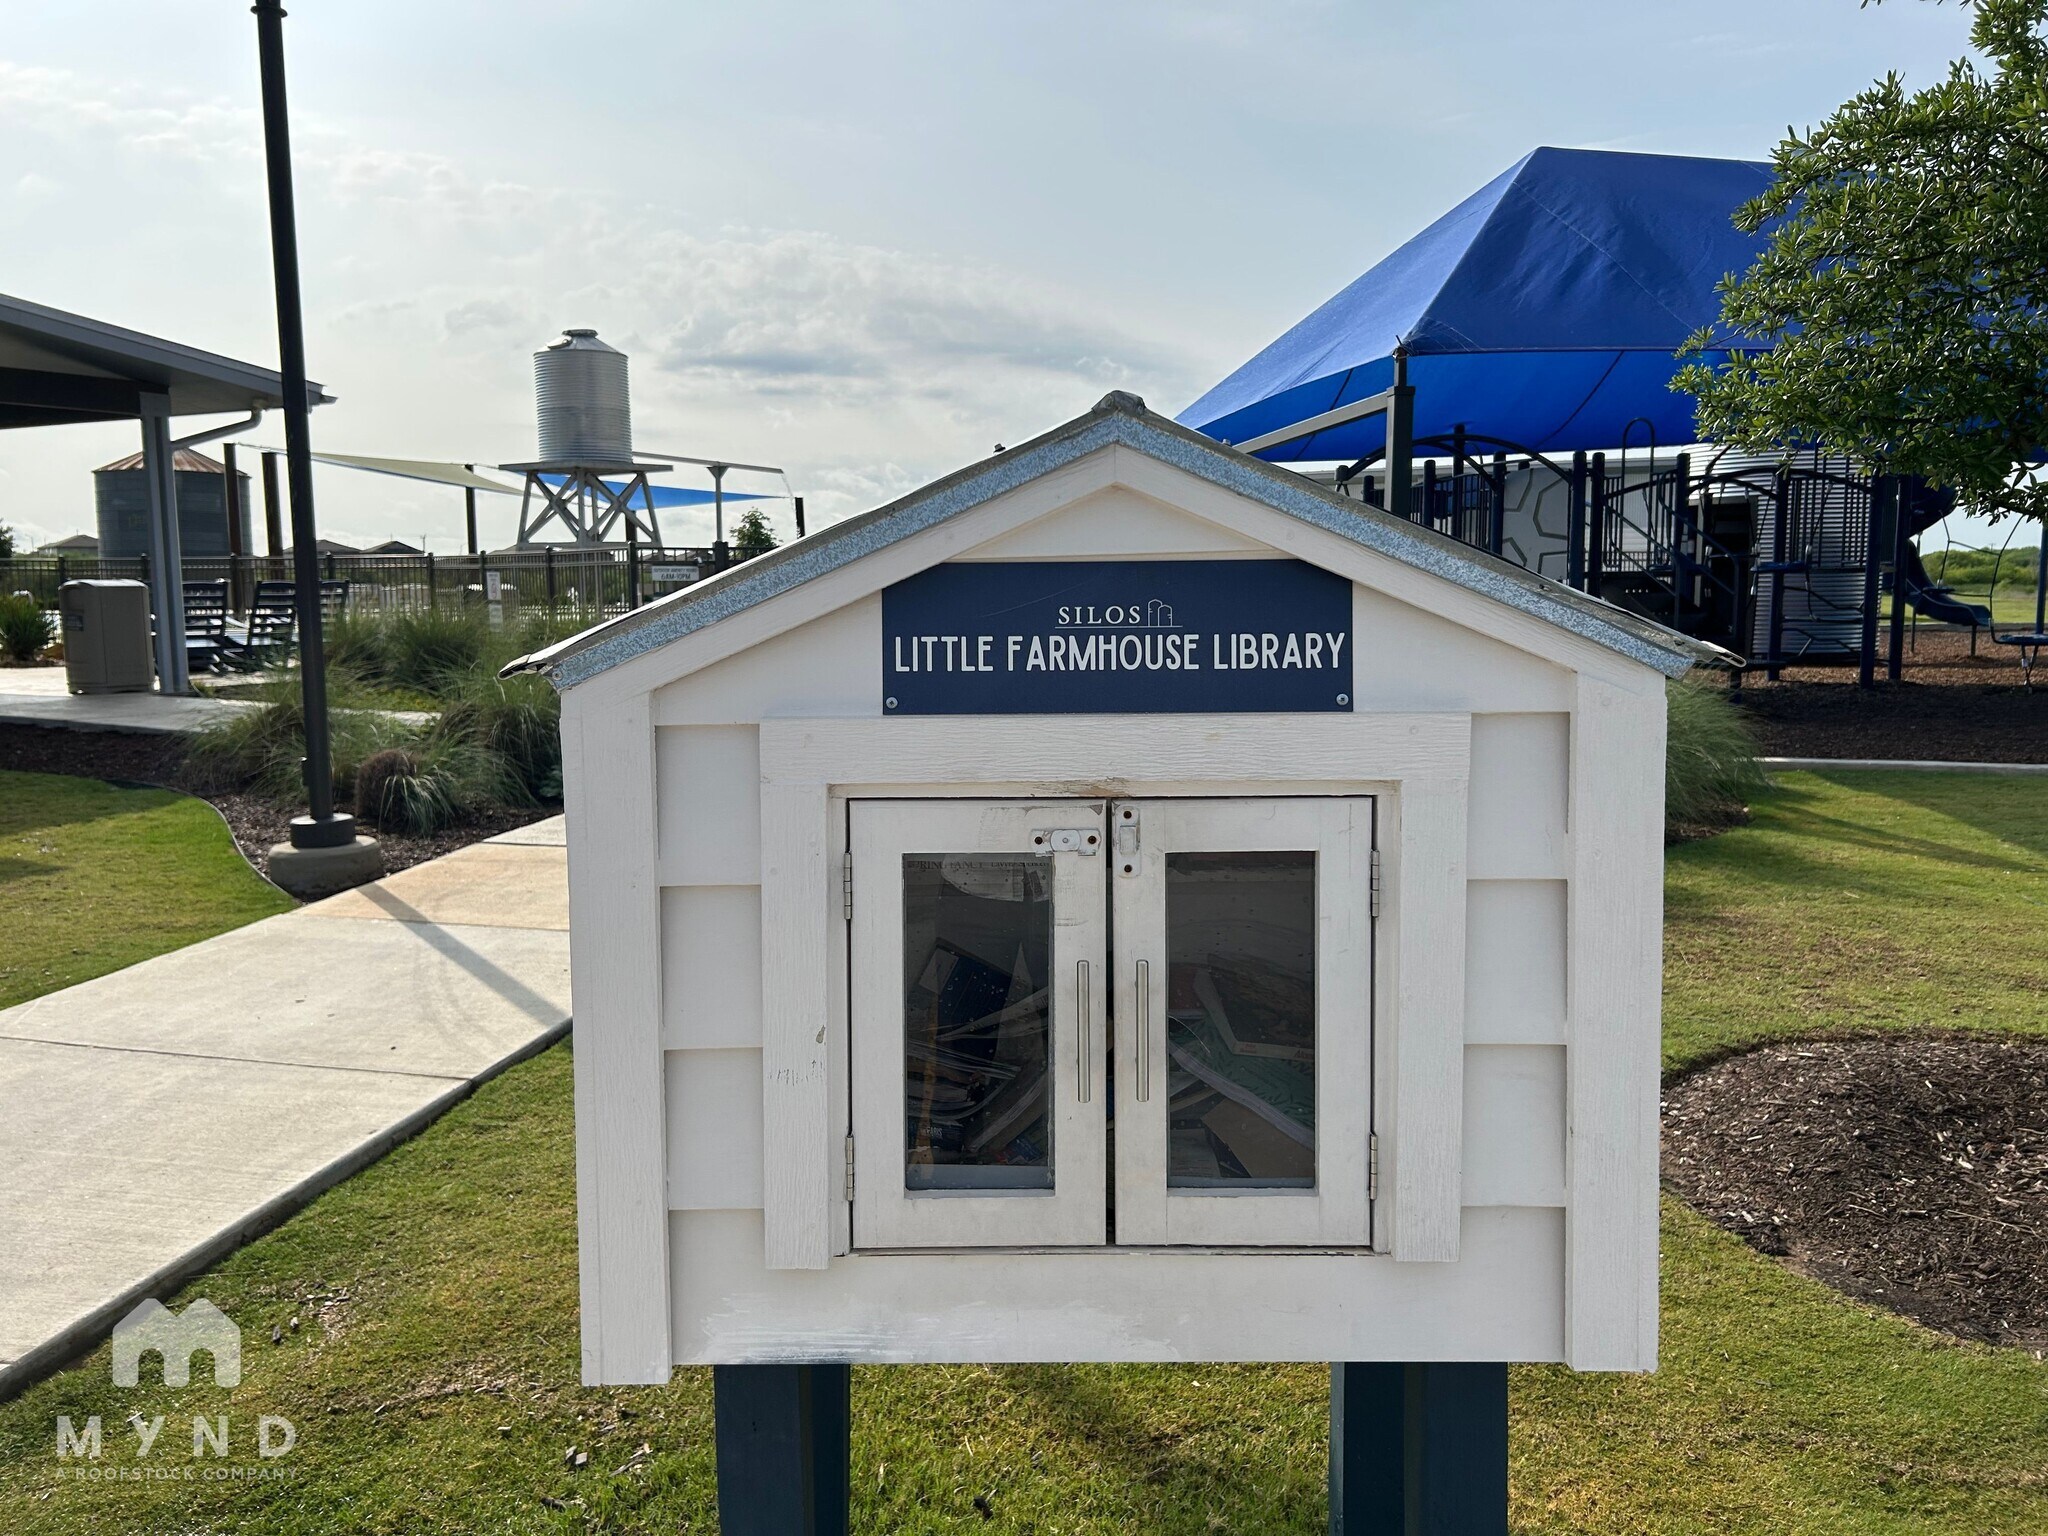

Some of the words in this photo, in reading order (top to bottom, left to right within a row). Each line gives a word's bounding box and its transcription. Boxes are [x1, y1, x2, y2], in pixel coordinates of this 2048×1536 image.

[1059, 606, 1140, 624] SILOS
[896, 636, 993, 671] LITTLE
[1008, 634, 1199, 671] FARMHOUSE
[1214, 633, 1345, 669] LIBRARY
